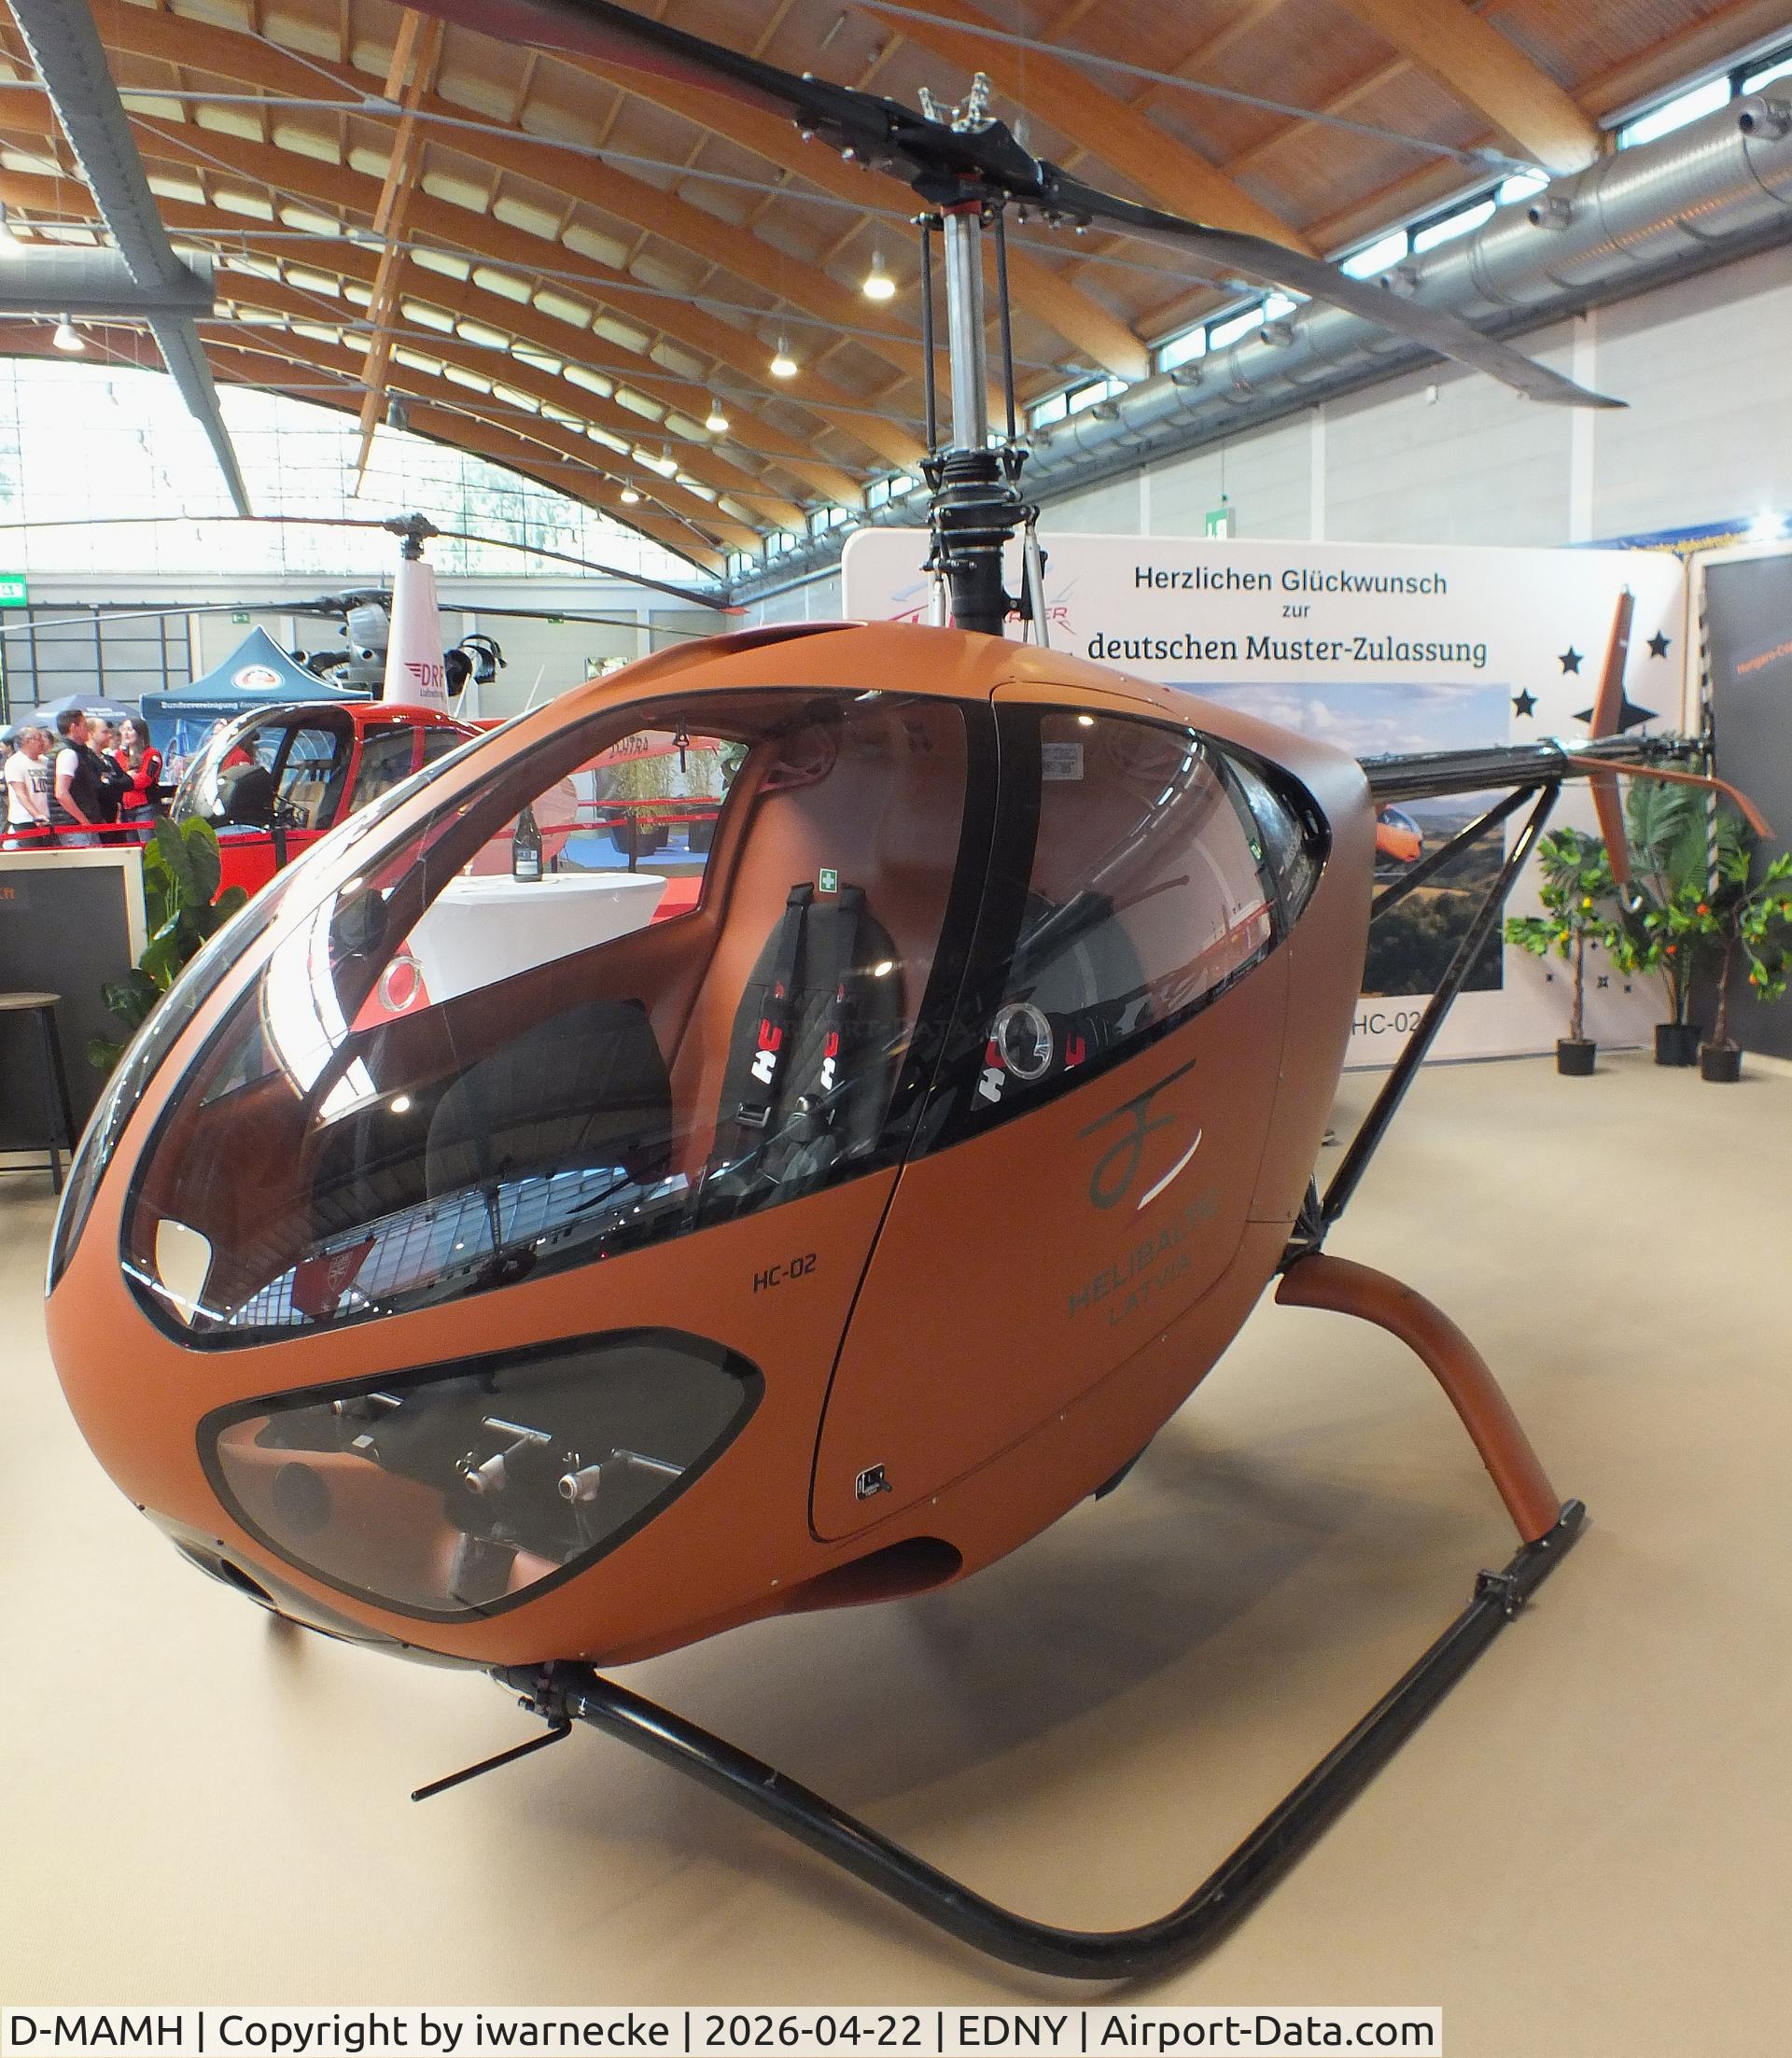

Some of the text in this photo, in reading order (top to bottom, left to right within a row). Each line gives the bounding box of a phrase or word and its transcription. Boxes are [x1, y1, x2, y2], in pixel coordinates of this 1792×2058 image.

[1134, 566, 1447, 595] Herzlichen Glückwunsch
[1282, 604, 1310, 618] zur
[1087, 632, 1487, 668] deutschen Muster-Zulassung
[1351, 1010, 1421, 1035] HC-02
[753, 1253, 818, 1294] HC-02
